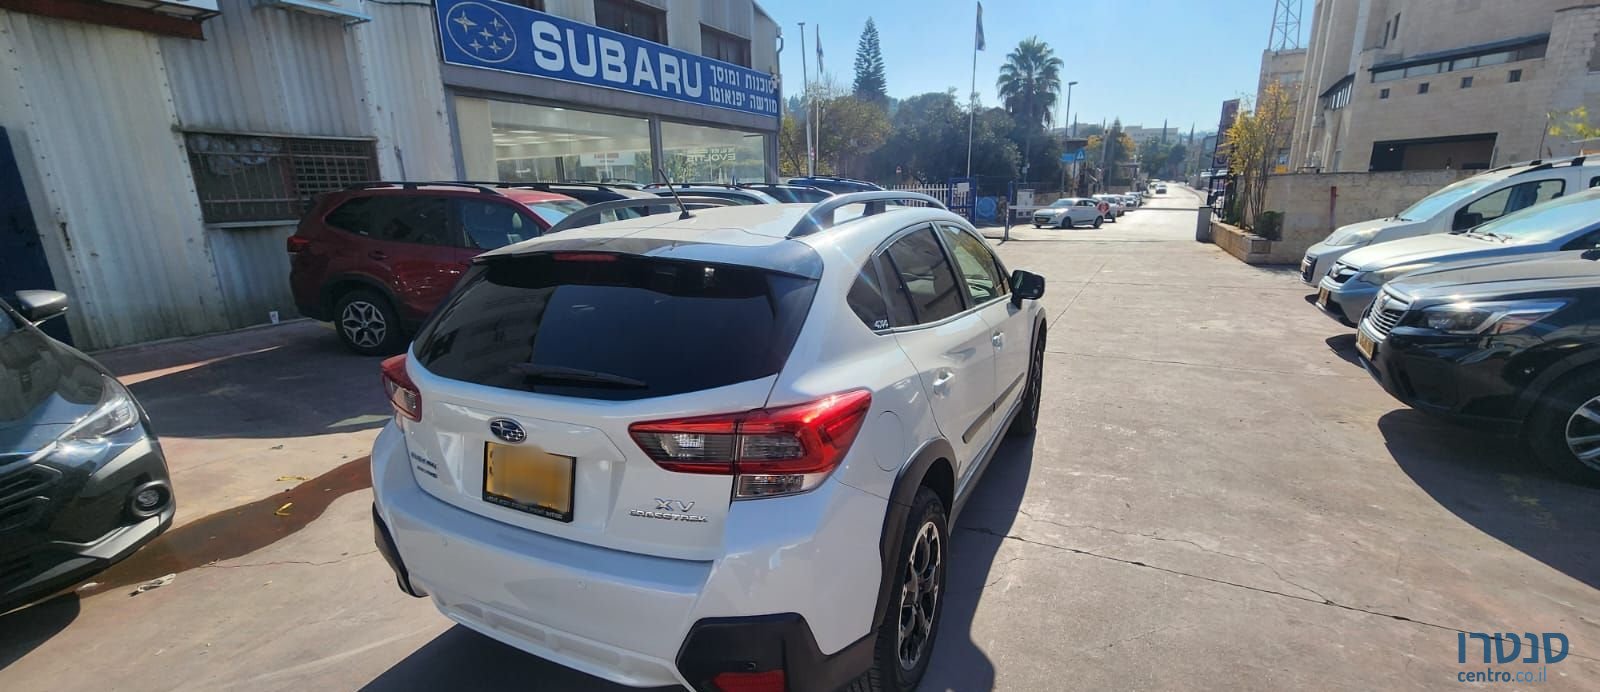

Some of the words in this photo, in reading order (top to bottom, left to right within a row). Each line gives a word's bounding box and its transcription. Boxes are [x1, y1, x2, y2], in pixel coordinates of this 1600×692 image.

[531, 20, 702, 98] SUBARU
[709, 64, 740, 87] ומוסך
[749, 94, 778, 113] מורשה
[654, 497, 696, 513] XV
[629, 509, 708, 523] CROSSTREK
